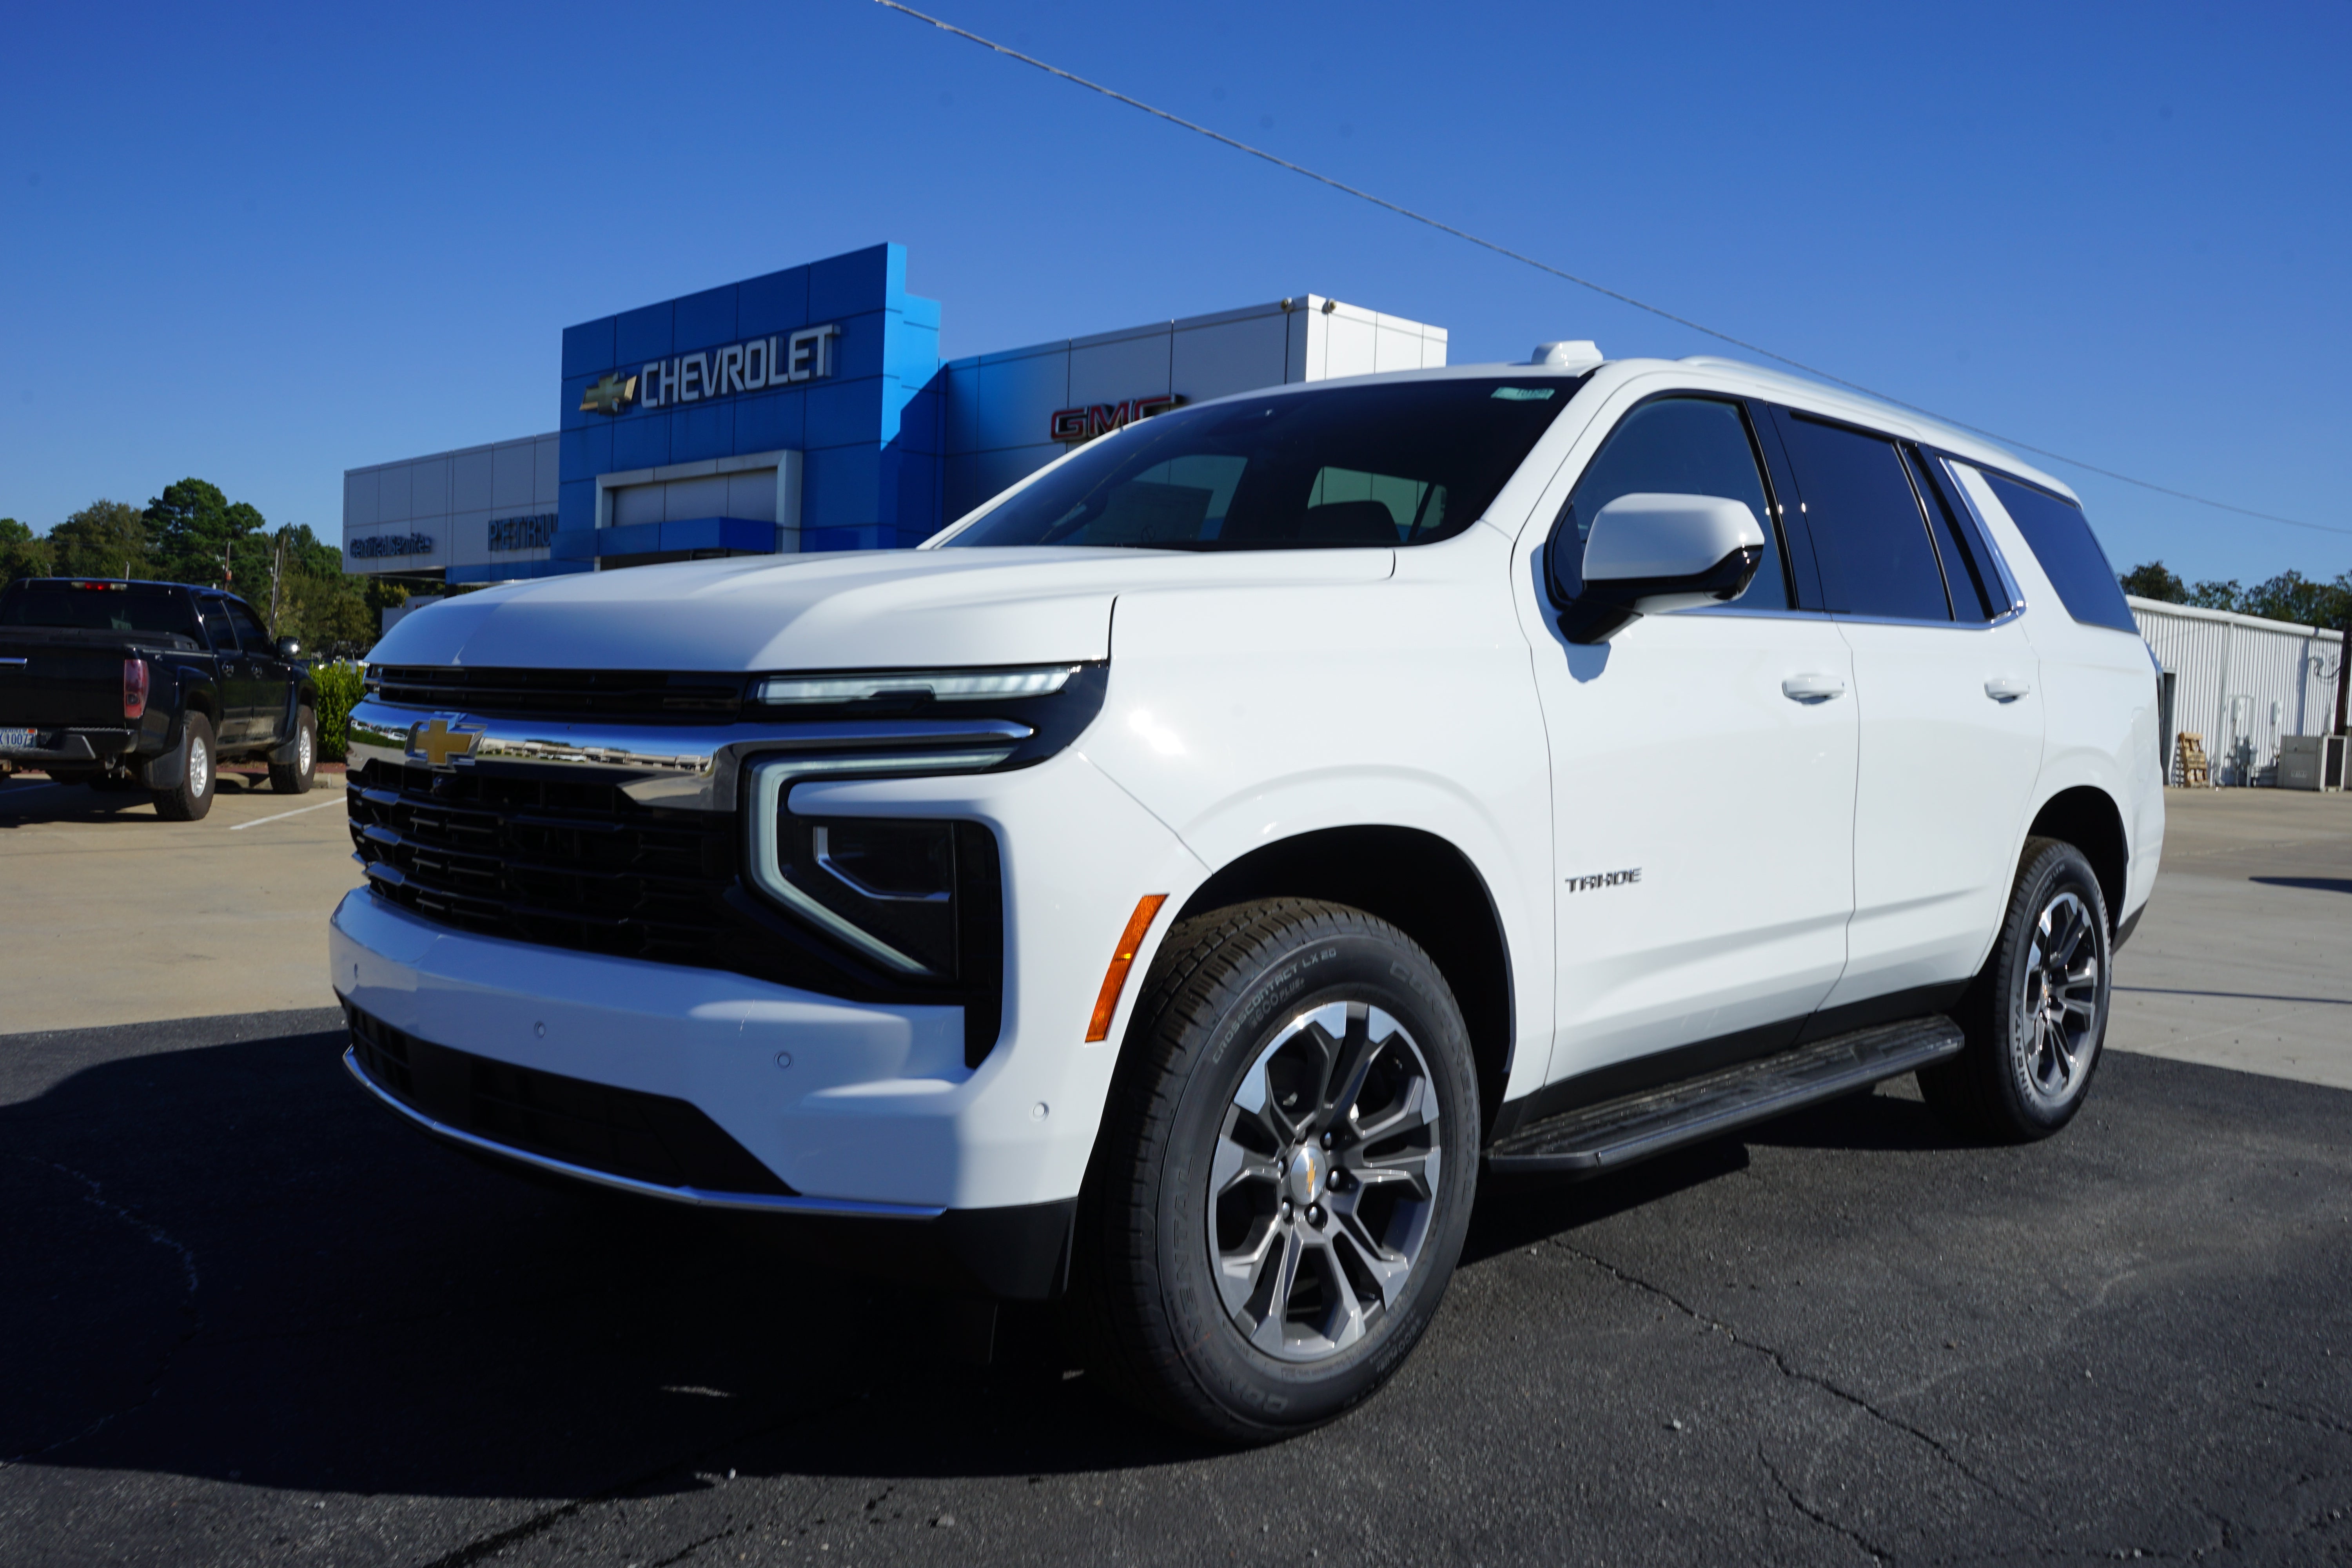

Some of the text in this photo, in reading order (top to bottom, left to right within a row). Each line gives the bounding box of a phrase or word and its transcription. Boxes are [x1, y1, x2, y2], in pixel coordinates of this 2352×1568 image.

[641, 324, 840, 408] CHEVROLET
[1051, 393, 1176, 440] GMC
[350, 534, 424, 557] Certified Service
[1565, 867, 1642, 893] TAHOE
[1212, 963, 1298, 1064] CROSSCONTACT
[1302, 953, 1318, 968] LX
